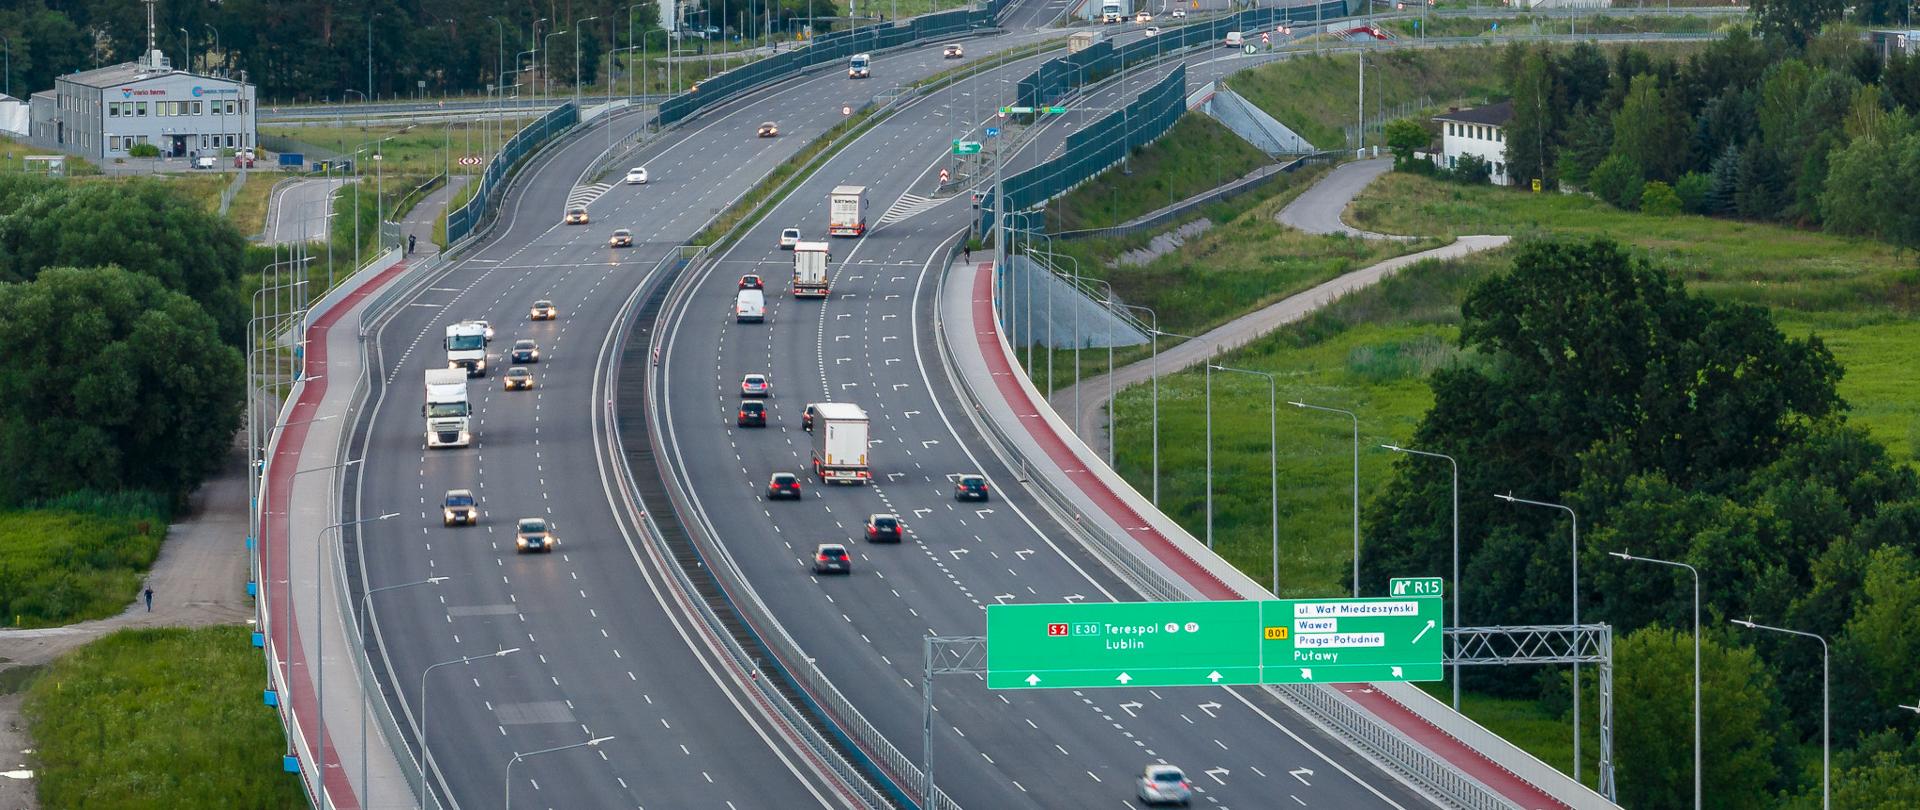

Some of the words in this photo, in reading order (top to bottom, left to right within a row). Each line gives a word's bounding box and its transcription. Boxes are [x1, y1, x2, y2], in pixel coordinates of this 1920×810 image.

[1414, 582, 1440, 594] R15
[1105, 623, 1158, 636] Terespol
[1299, 621, 1333, 630] Wawer
[1267, 629, 1286, 638] 801
[1106, 638, 1144, 649] Lublin
[1294, 651, 1338, 663] Puławy
